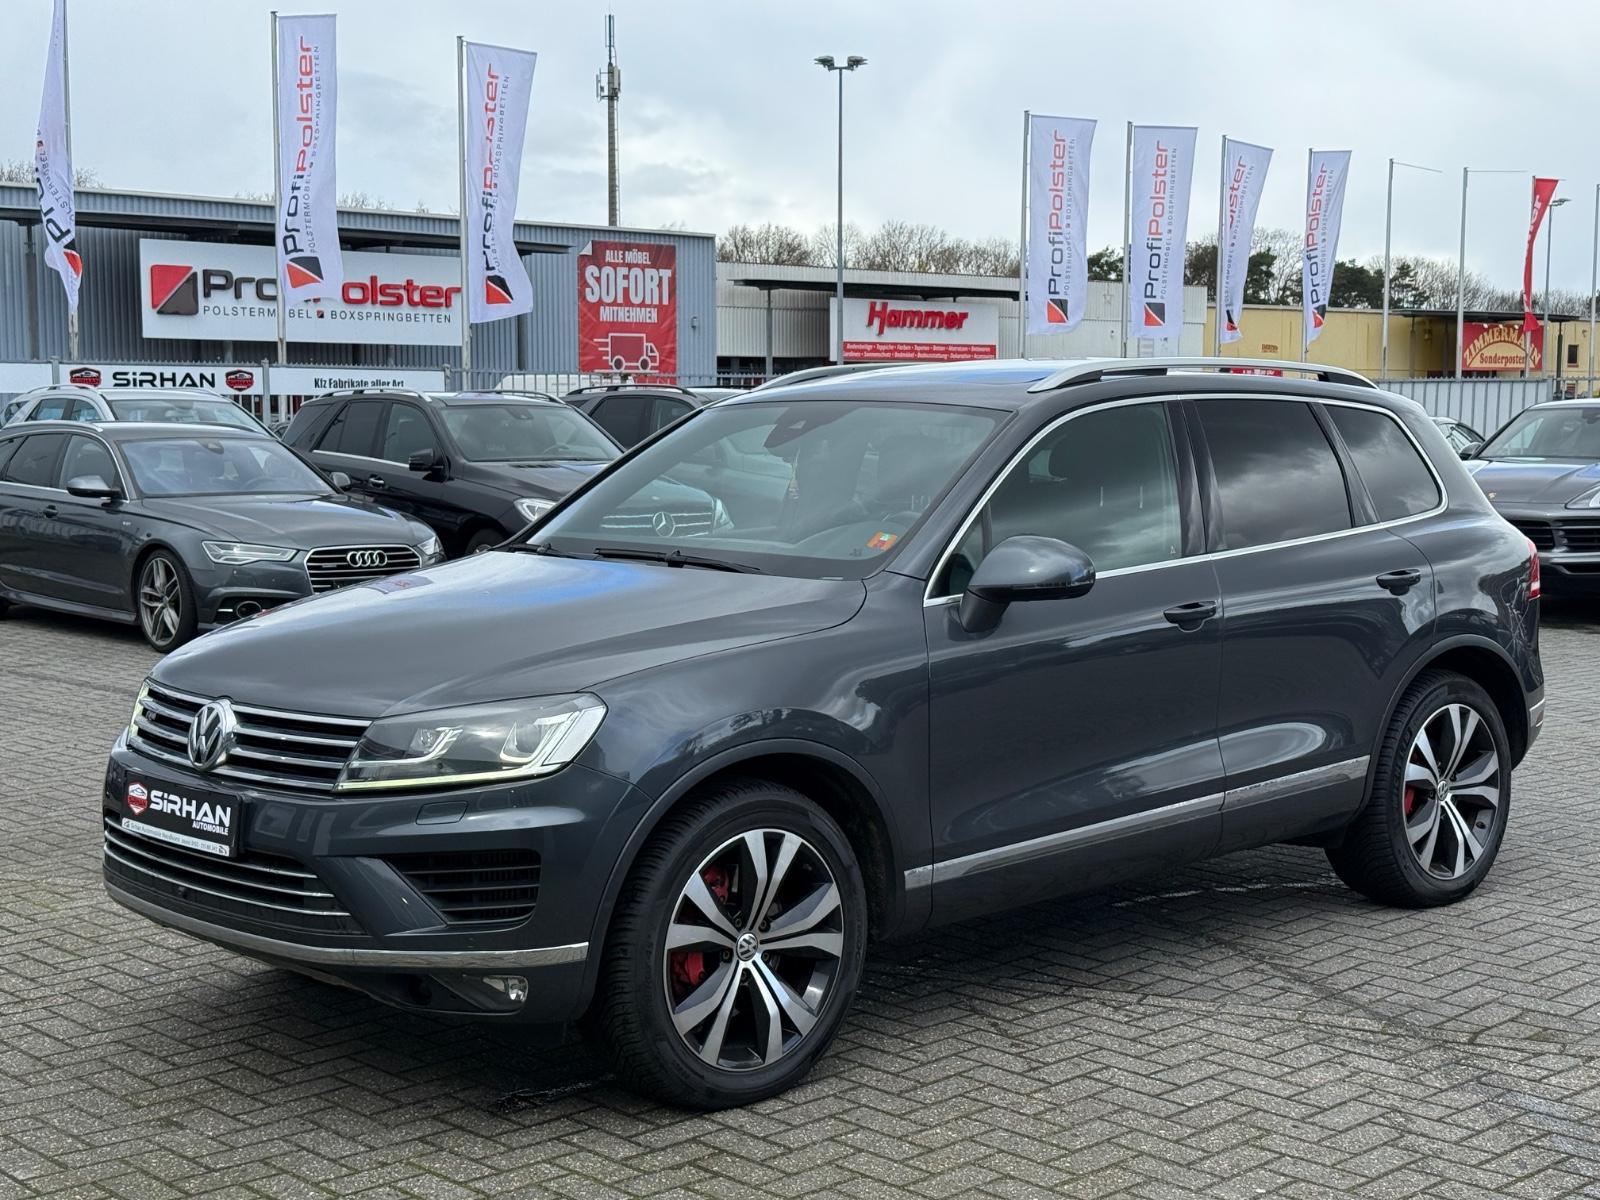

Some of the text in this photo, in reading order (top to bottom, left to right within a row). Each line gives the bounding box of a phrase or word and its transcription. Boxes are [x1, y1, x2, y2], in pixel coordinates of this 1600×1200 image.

[283, 36, 313, 255] ProfiPolster
[1048, 129, 1066, 295] ProfiPolster
[1144, 140, 1168, 299] ProfiPolster
[1306, 163, 1328, 305] ProfiPolster
[605, 249, 652, 265] ALLE MÖBEL
[585, 265, 672, 305] SOFORT
[203, 305, 452, 324] POLSTERMBEL BOXSPRINGBETTEN
[600, 305, 658, 323] MITNEHMEN
[866, 301, 969, 336] Hammer
[1463, 327, 1541, 367] ZIMMERMAN
[314, 378, 405, 389] Kfz Fabrikate aller Art
[192, 821, 229, 836] AUTOMOBILE
